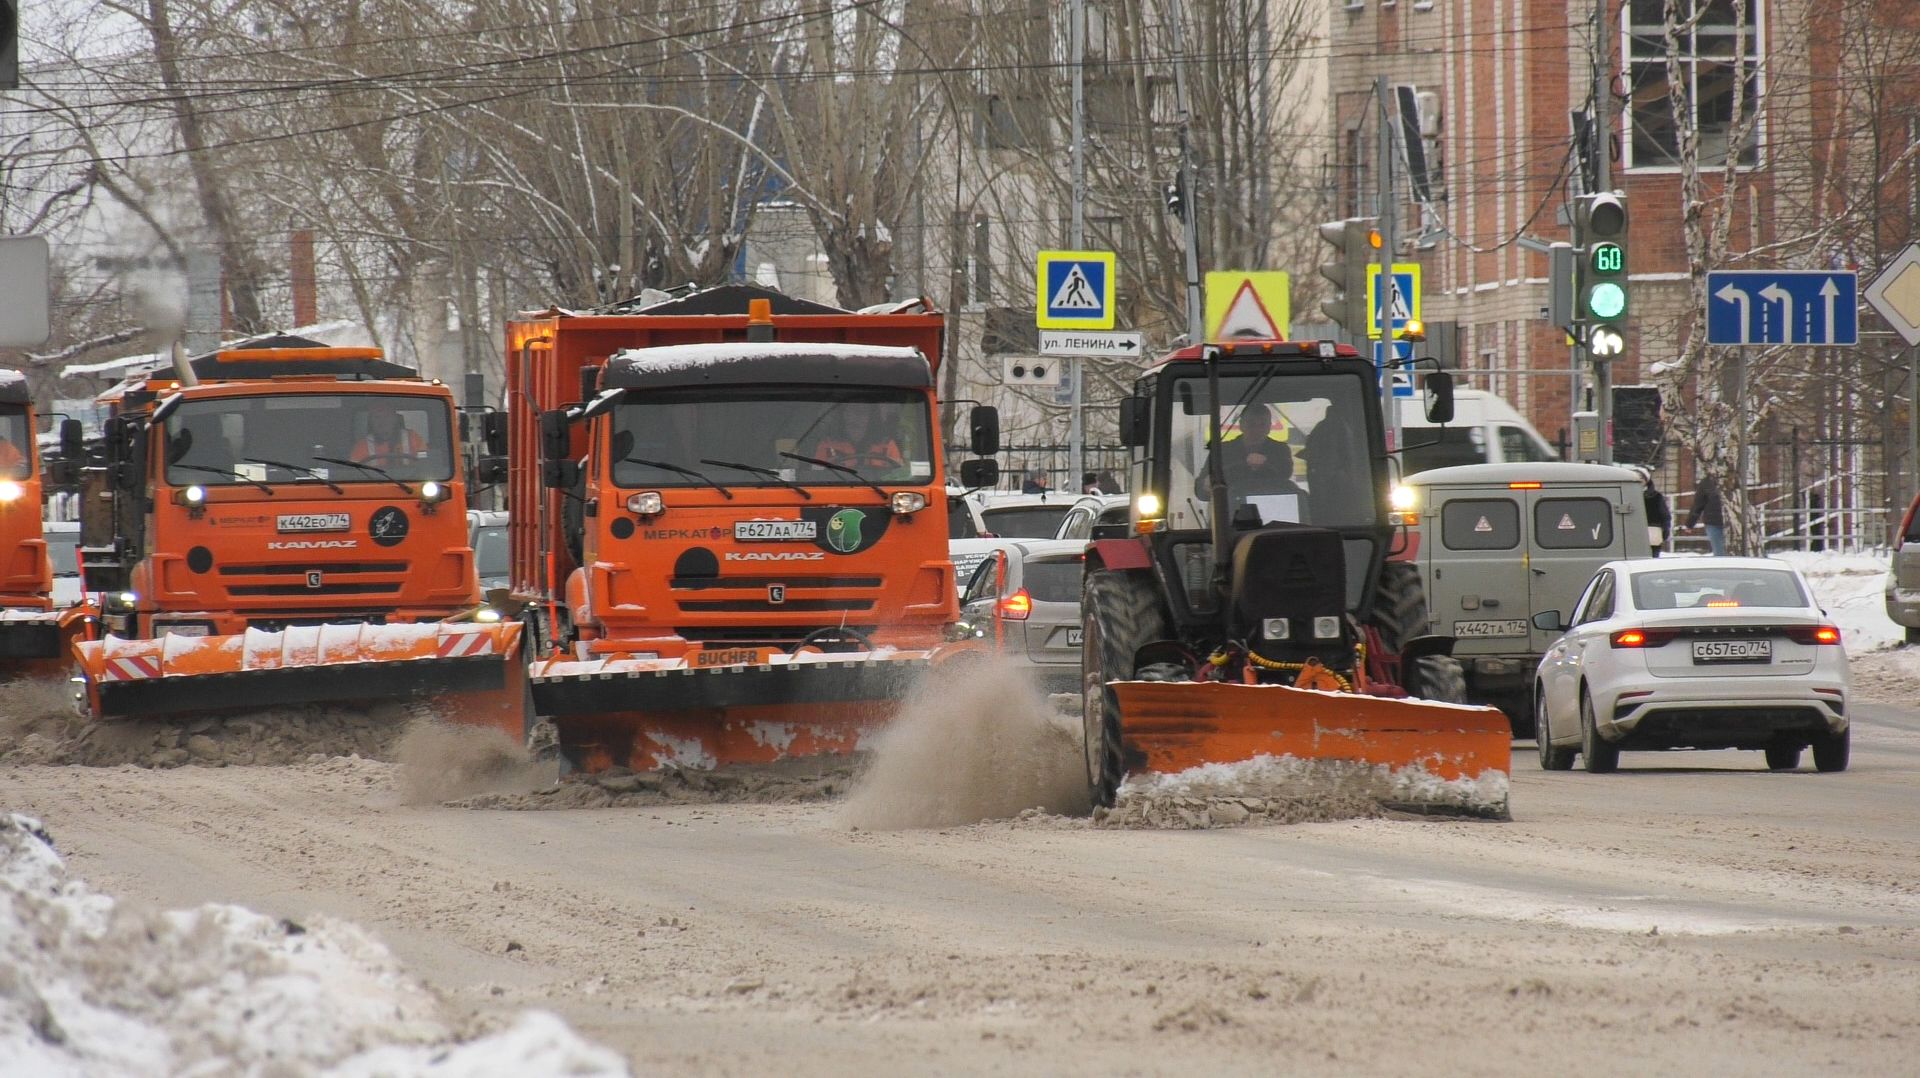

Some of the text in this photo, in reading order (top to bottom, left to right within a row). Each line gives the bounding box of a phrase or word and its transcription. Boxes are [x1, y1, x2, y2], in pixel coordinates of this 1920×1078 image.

[1598, 247, 1621, 270] 60
[1044, 338, 1115, 350] ул. ЛЕНИНА
[267, 540, 358, 550] KAMAZ
[725, 552, 825, 561] KAMAZ
[697, 650, 758, 665] BUCHER
